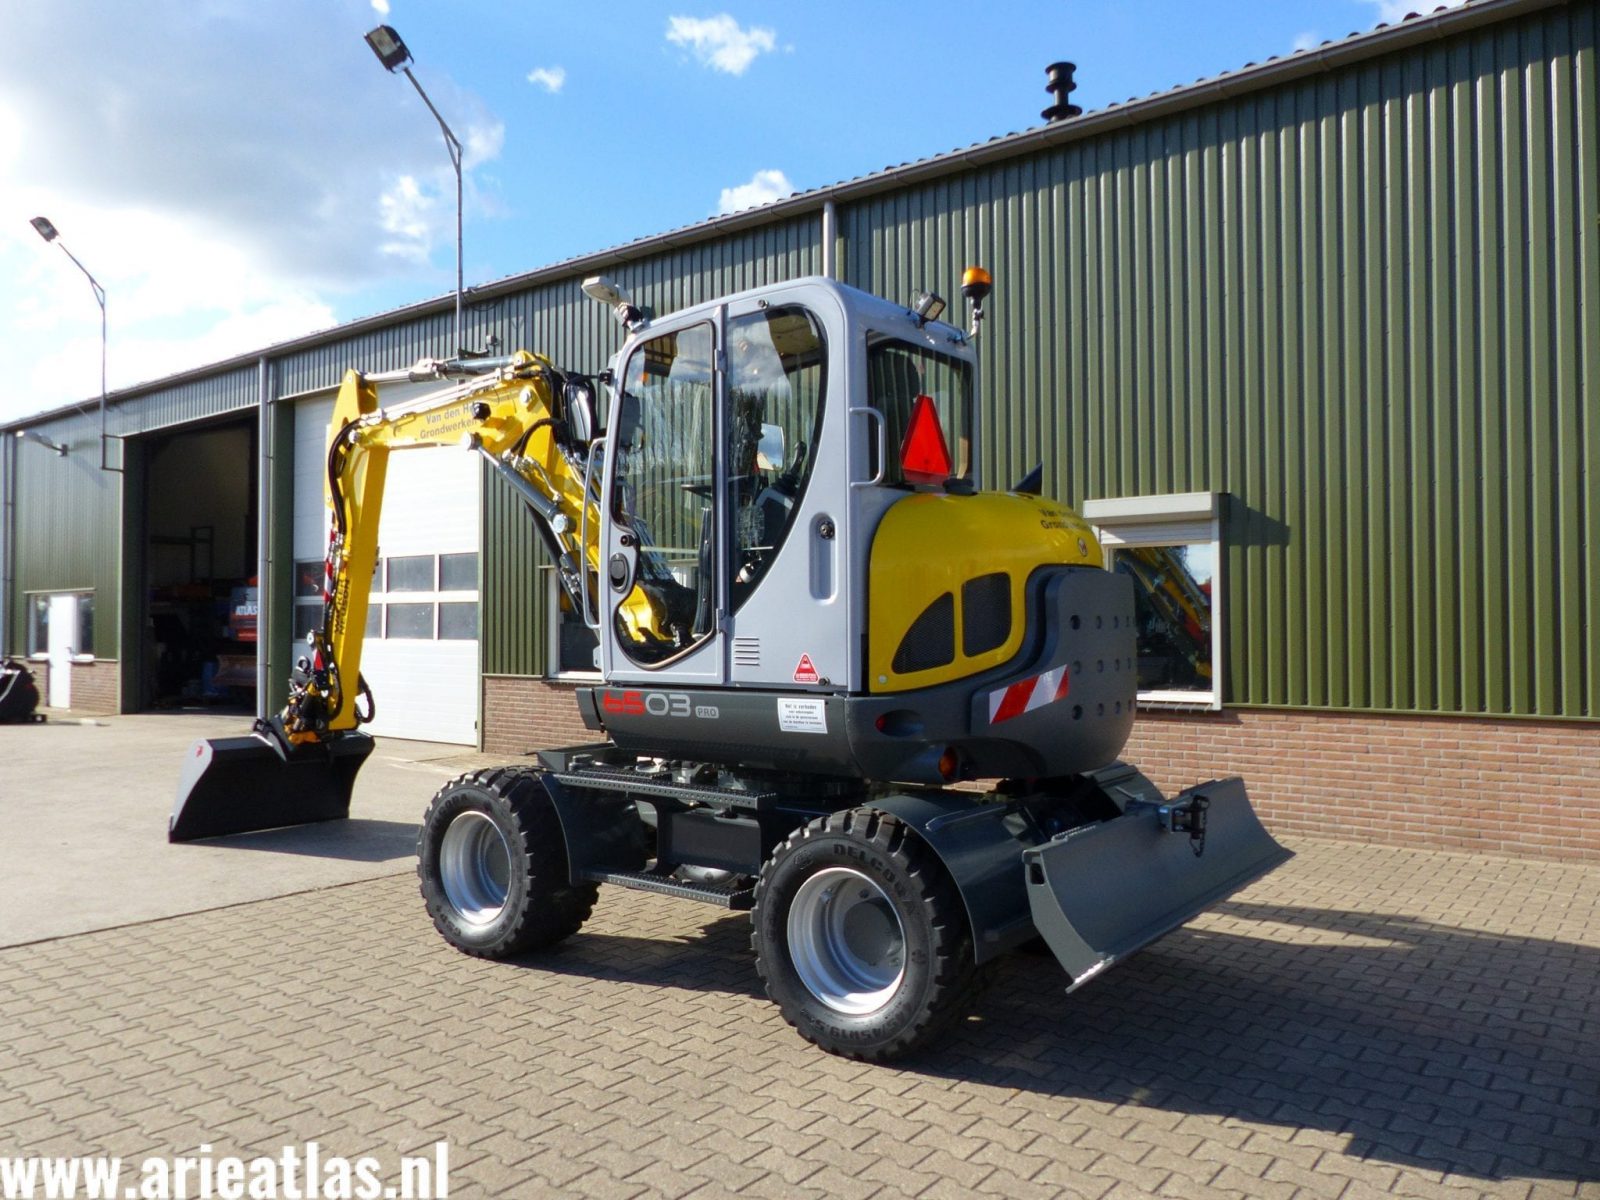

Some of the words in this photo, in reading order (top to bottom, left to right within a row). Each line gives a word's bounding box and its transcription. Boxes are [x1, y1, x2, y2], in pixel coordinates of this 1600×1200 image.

[426, 413, 441, 424] Van
[444, 408, 460, 419] den
[420, 419, 477, 439] Grondwerken
[697, 707, 717, 717] PRO
